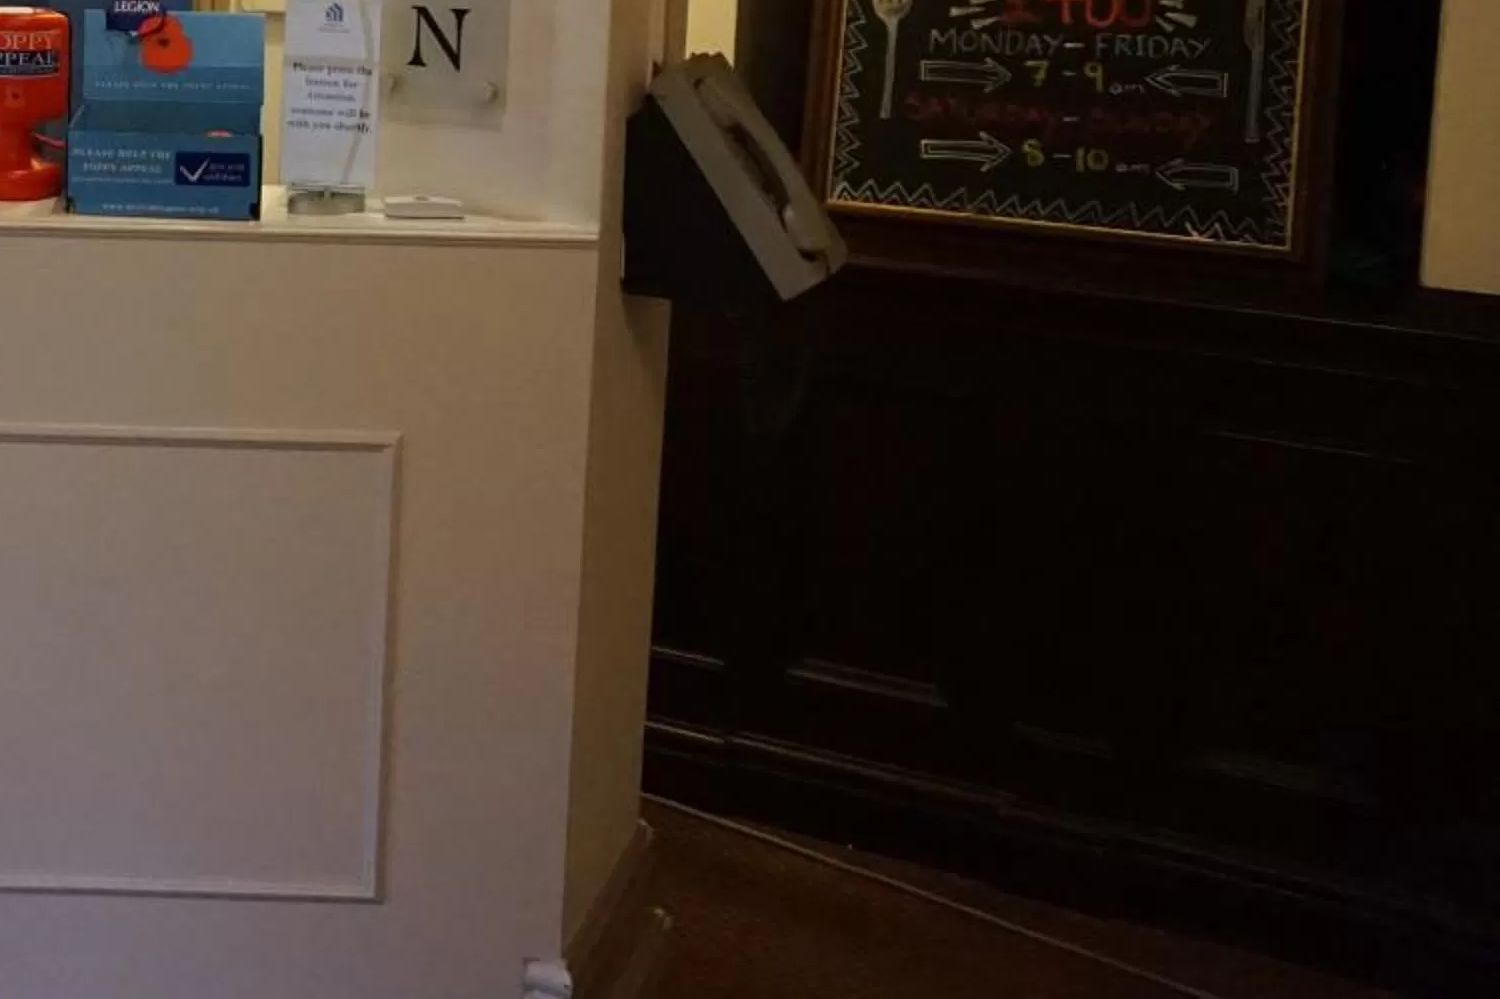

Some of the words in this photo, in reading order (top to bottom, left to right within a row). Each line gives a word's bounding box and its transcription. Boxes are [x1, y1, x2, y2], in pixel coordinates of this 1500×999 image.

[113, 0, 161, 13] LEGION
[929, 28, 1063, 56] MONDAY
[1095, 32, 1212, 58] FRIDAY
